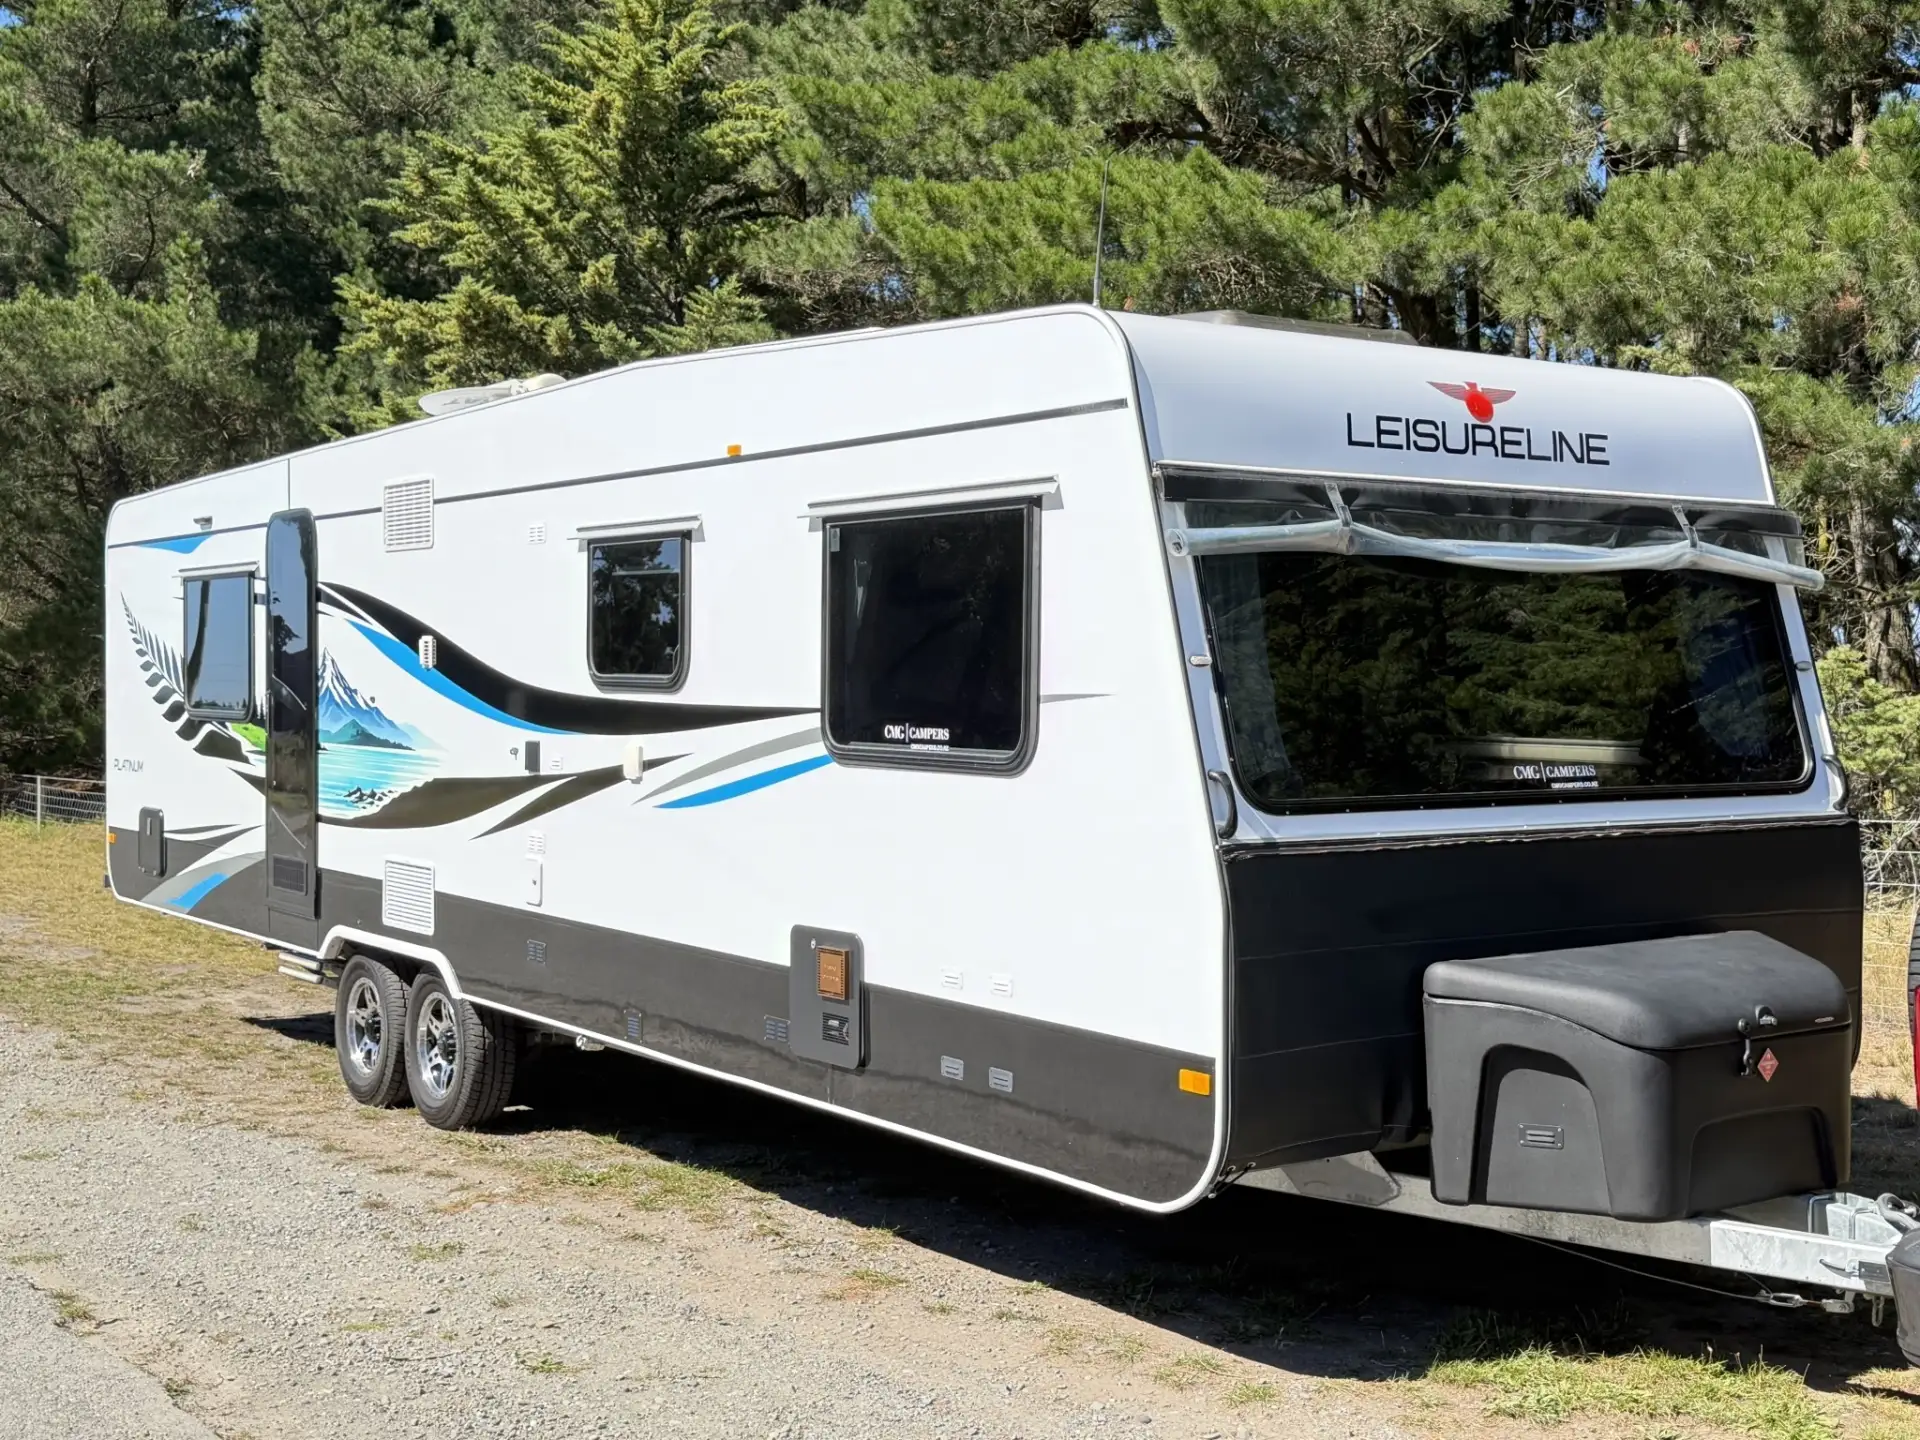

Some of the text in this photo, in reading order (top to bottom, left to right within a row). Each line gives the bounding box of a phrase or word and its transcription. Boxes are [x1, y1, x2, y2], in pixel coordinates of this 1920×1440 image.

[1346, 412, 1610, 466] LEISURELINE
[884, 724, 950, 741] CMG CAMPERS
[1513, 764, 1597, 780] CMG CAMPERS
